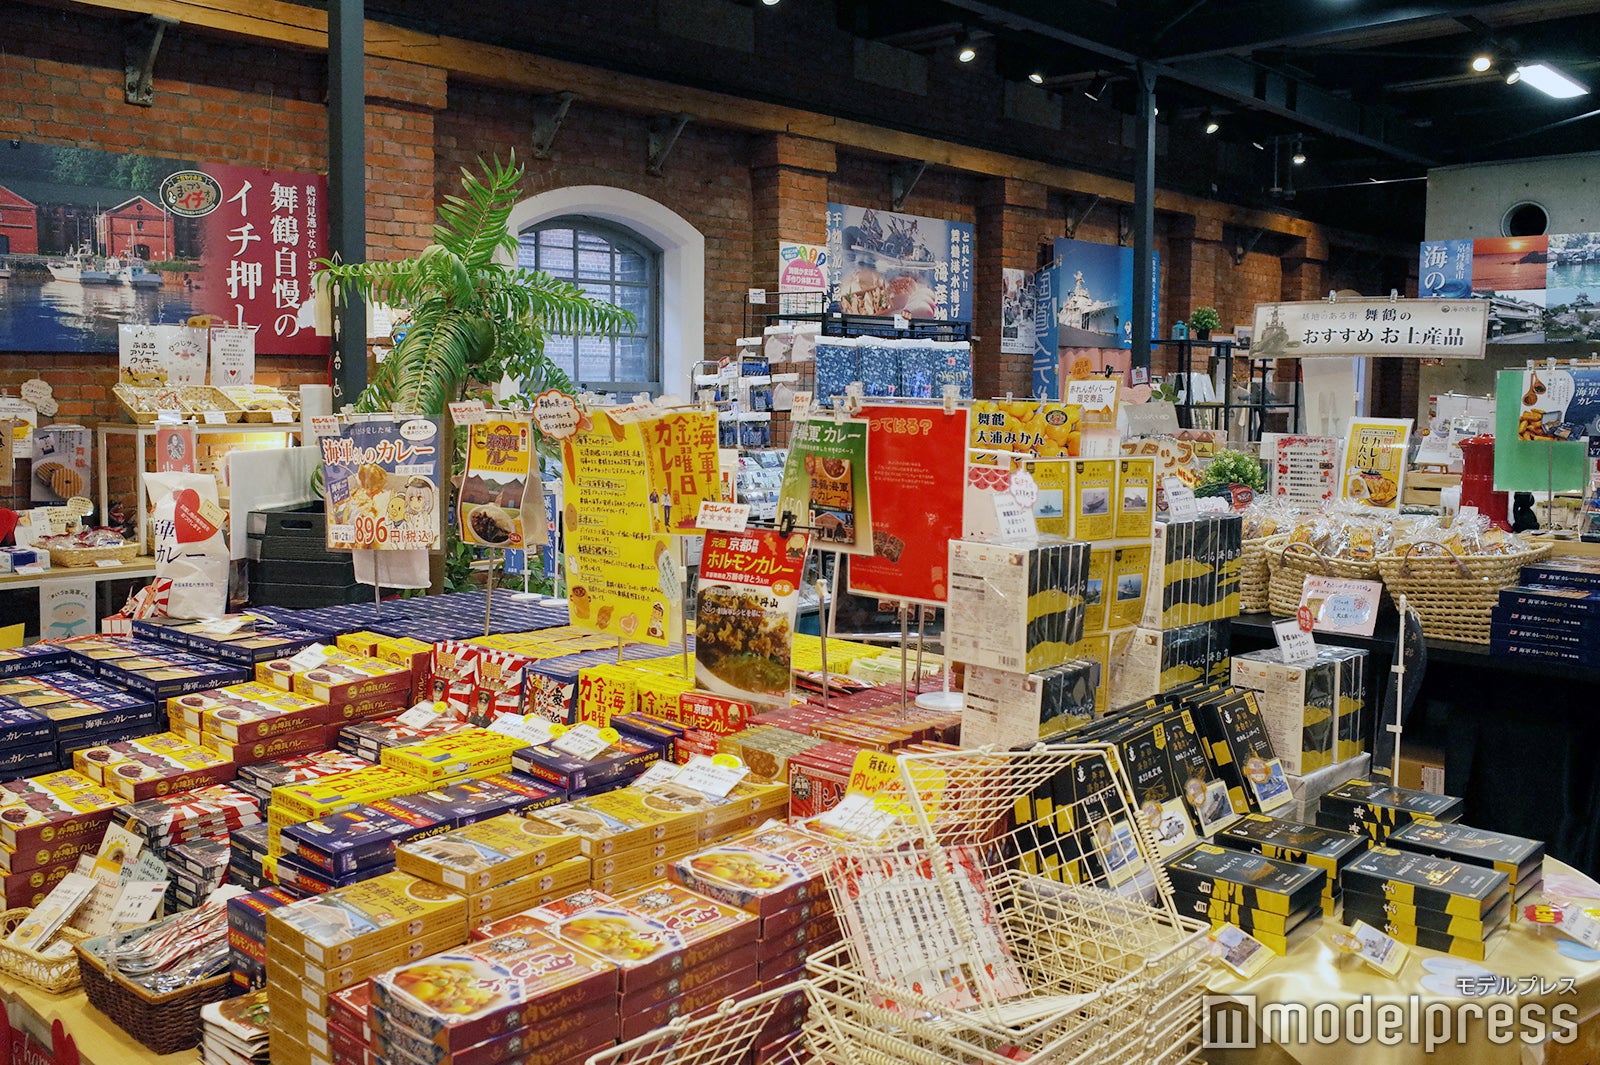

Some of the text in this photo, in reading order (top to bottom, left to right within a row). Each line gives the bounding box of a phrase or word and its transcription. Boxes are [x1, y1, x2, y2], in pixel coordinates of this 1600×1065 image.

[226, 180, 262, 334] イチ押し
[270, 182, 300, 337] 舞鶴自慢の
[1365, 308, 1412, 321] 舞鶴の
[1302, 325, 1464, 346] おすすめ お土産品
[1070, 384, 1116, 394] 赤れんがパーク
[1077, 394, 1104, 403] 限定商品
[692, 414, 716, 422] まいづる
[978, 412, 1005, 426] 舞鶴
[976, 430, 1044, 446] 大浦みかん
[322, 437, 436, 466] 海軍さんのカレー
[655, 419, 674, 495] カレー
[671, 415, 697, 496] 金曜日
[692, 423, 718, 483] 海軍
[1357, 436, 1369, 467] せんべい
[1370, 437, 1381, 466] カレー
[702, 503, 732, 514] 辛さレベル
[355, 516, 388, 544] 896
[728, 538, 752, 553] 京都
[157, 545, 206, 564] カレー
[707, 550, 794, 575] ホルモンカレー
[774, 583, 790, 593] 中辛
[760, 597, 778, 608] 丹山
[183, 679, 228, 691] 海軍さんのカレー
[85, 714, 136, 729] 海軍さんのカレー
[683, 713, 736, 733] ホルモンカレー
[1156, 726, 1163, 737] 23
[625, 752, 659, 766] ホルモンカレー
[869, 755, 896, 774] 舞鶴は
[406, 824, 452, 842] ホルモンカレー
[1198, 881, 1212, 893] 自
[1194, 900, 1208, 913] 自
[229, 931, 264, 958] ホルモンカレー
